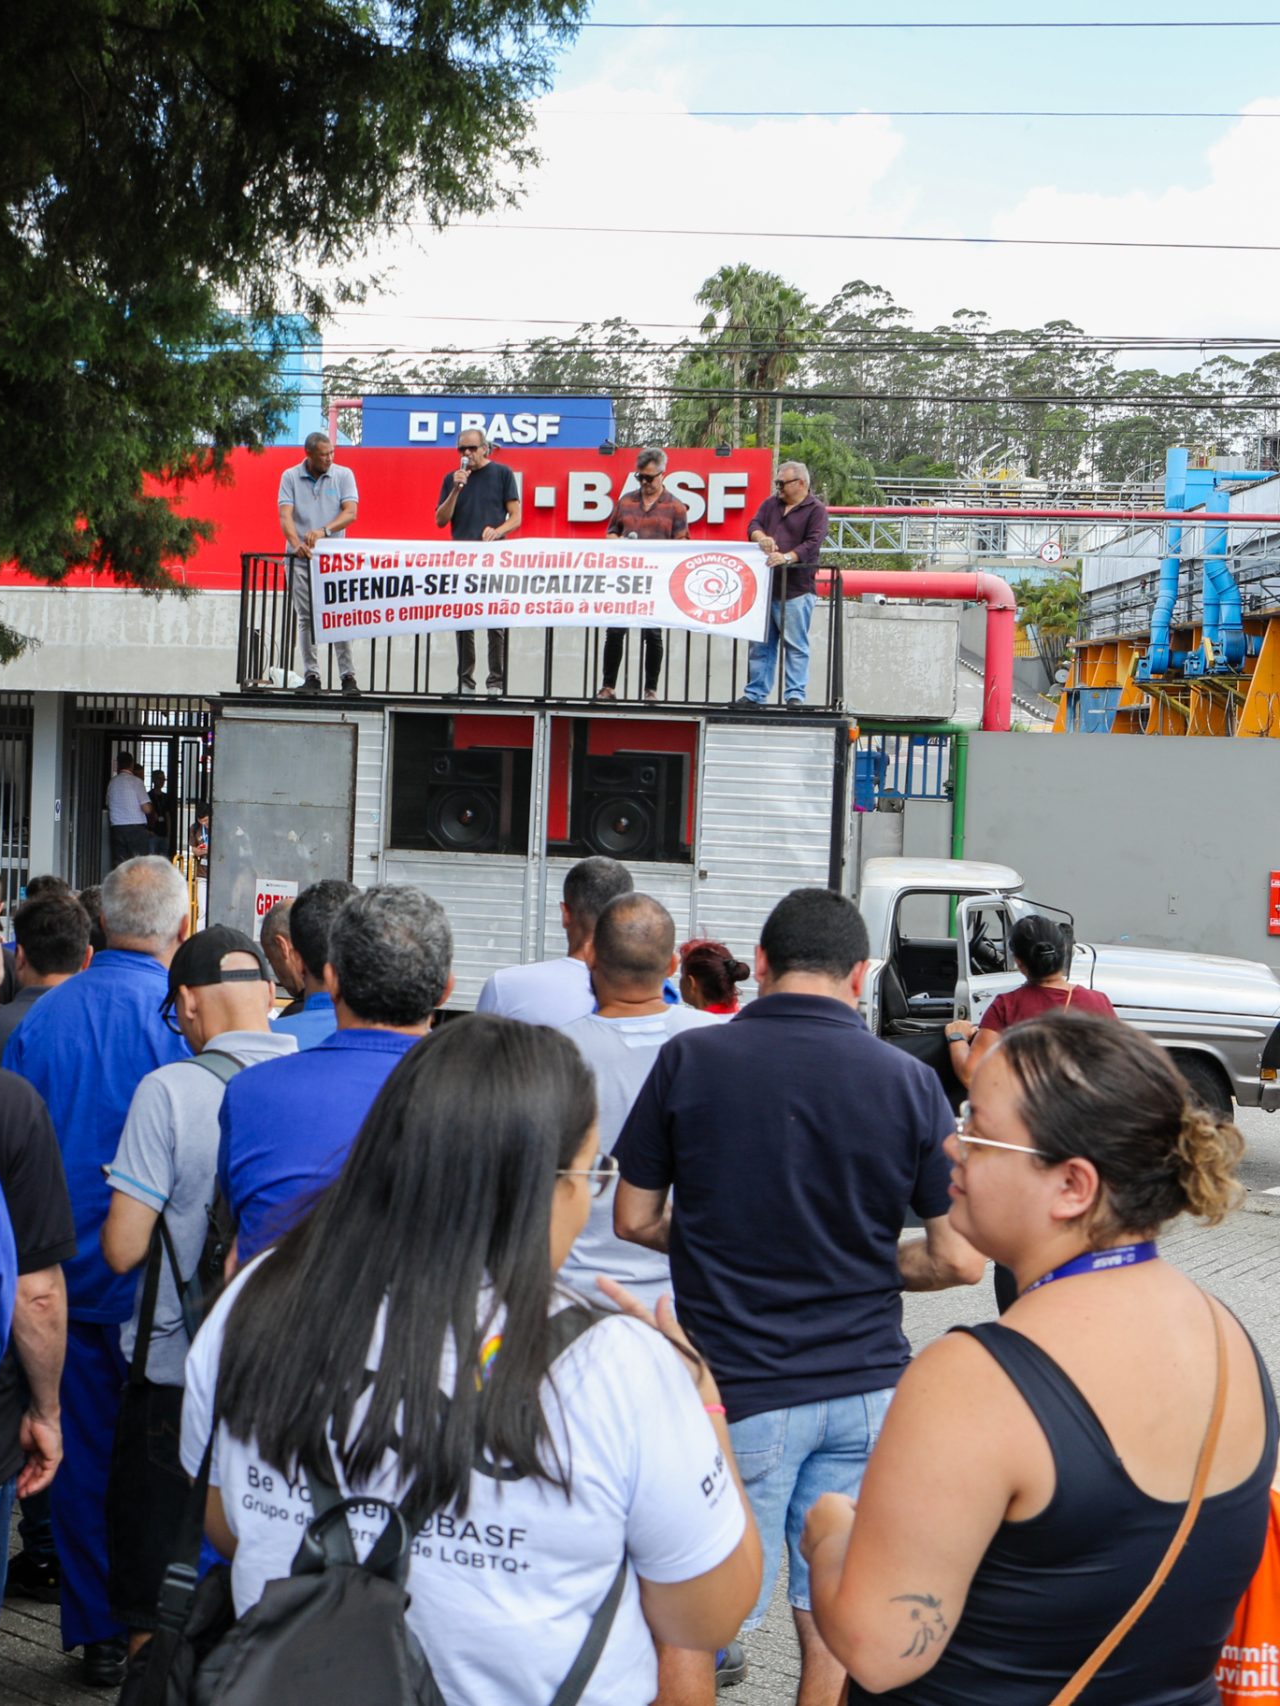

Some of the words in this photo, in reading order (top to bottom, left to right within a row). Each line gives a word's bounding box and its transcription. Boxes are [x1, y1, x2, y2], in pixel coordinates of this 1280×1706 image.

[461, 413, 561, 444] BASF
[568, 471, 749, 524] BSF
[319, 552, 366, 574] BASF
[370, 551, 400, 569] vai
[404, 550, 478, 568] vender
[481, 553, 495, 567] a
[499, 551, 659, 569] Suvinil/Glasu...
[324, 573, 459, 605] DEFENDA-SE!
[464, 573, 653, 595] SINDICALIZE-SE!
[322, 607, 381, 630] Direitos
[385, 608, 395, 622] e
[398, 602, 484, 622] empregos
[487, 599, 520, 616] não
[524, 599, 575, 615] estão
[578, 600, 589, 614] à
[593, 601, 655, 616] venda!
[247, 1465, 274, 1493] Be
[241, 1494, 289, 1521] Grupo
[440, 1546, 531, 1575] LGBTQ+
[1221, 1642, 1279, 1664] mmit
[1215, 1663, 1280, 1687] uvinil
